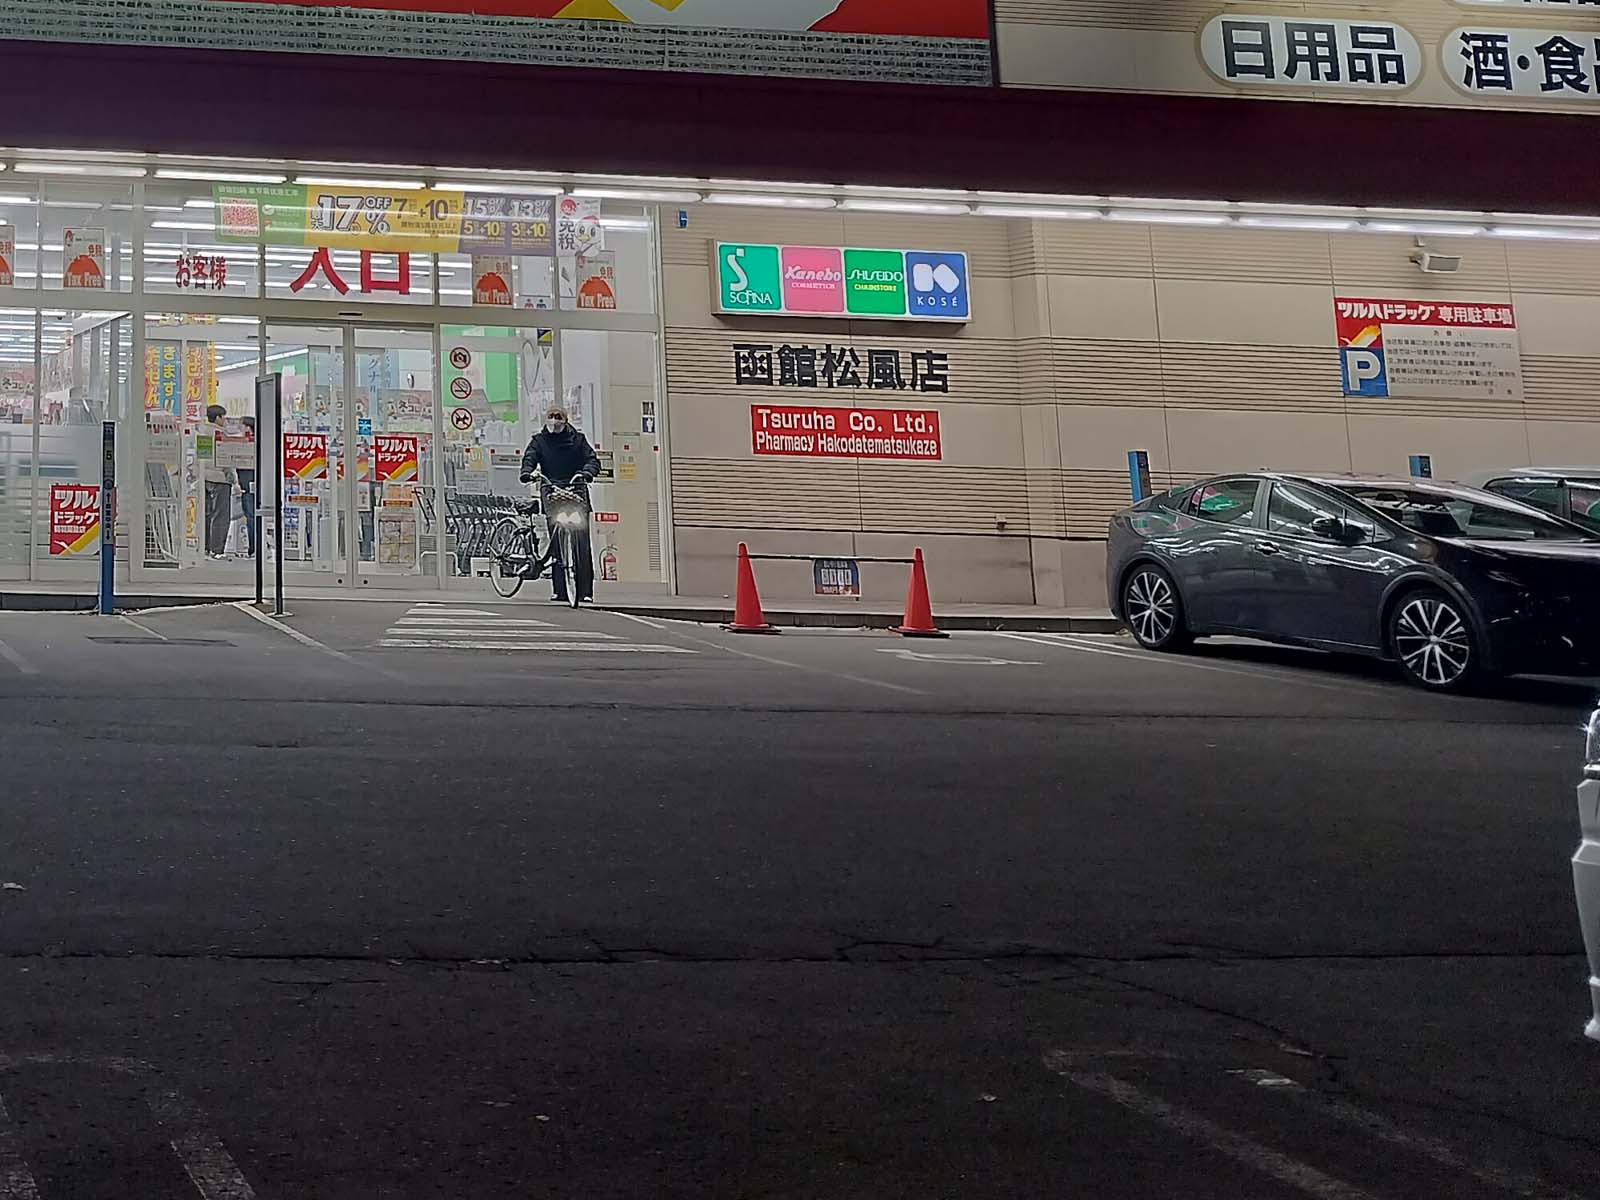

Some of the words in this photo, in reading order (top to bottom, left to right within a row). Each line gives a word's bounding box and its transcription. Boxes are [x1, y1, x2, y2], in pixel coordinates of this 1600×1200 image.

[1220, 20, 1406, 86] 日用品
[1460, 31, 1600, 94] 酒・食
[558, 216, 576, 250] 免税
[176, 254, 226, 290] お客様
[785, 266, 841, 282] Kanebo
[847, 269, 904, 282] SHISEIDO
[917, 295, 958, 307] KOSÉ
[1337, 302, 1434, 320] ツルハドラッグ
[1438, 306, 1513, 324] 専用駐車場
[733, 344, 949, 393] 函館松風店
[1346, 350, 1381, 391] P
[757, 408, 835, 430] Tsuruha
[849, 412, 882, 432] Co.
[893, 413, 933, 434] Ltd,
[286, 435, 324, 449] ツルハ
[377, 438, 415, 452] ツルハ
[756, 431, 814, 452] Pharmacy
[818, 433, 937, 455] Hakodatematsukaze
